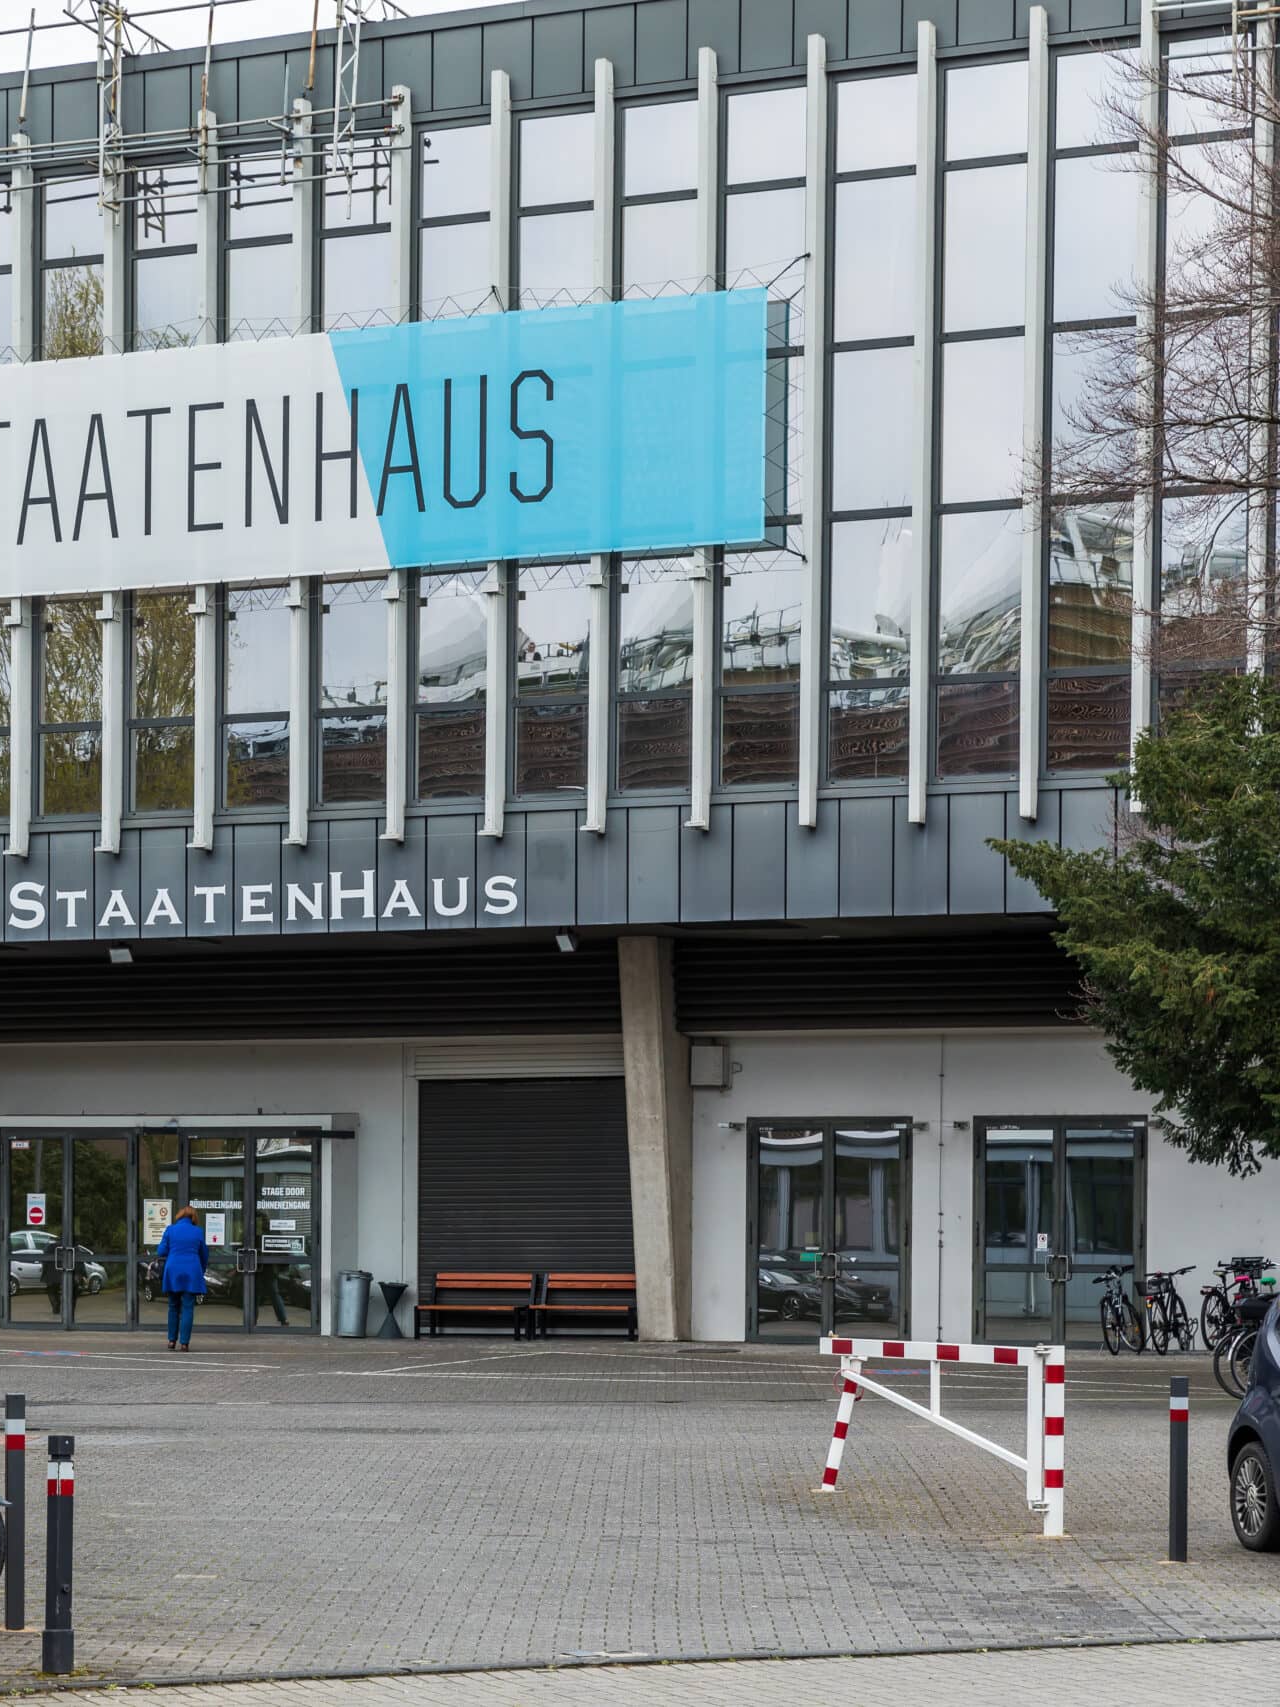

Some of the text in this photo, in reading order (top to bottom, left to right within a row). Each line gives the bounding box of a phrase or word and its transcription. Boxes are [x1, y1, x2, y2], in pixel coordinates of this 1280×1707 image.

[261, 1187, 304, 1196] STAGE DOOR
[256, 1200, 310, 1210] BÜHNENEINGANG
